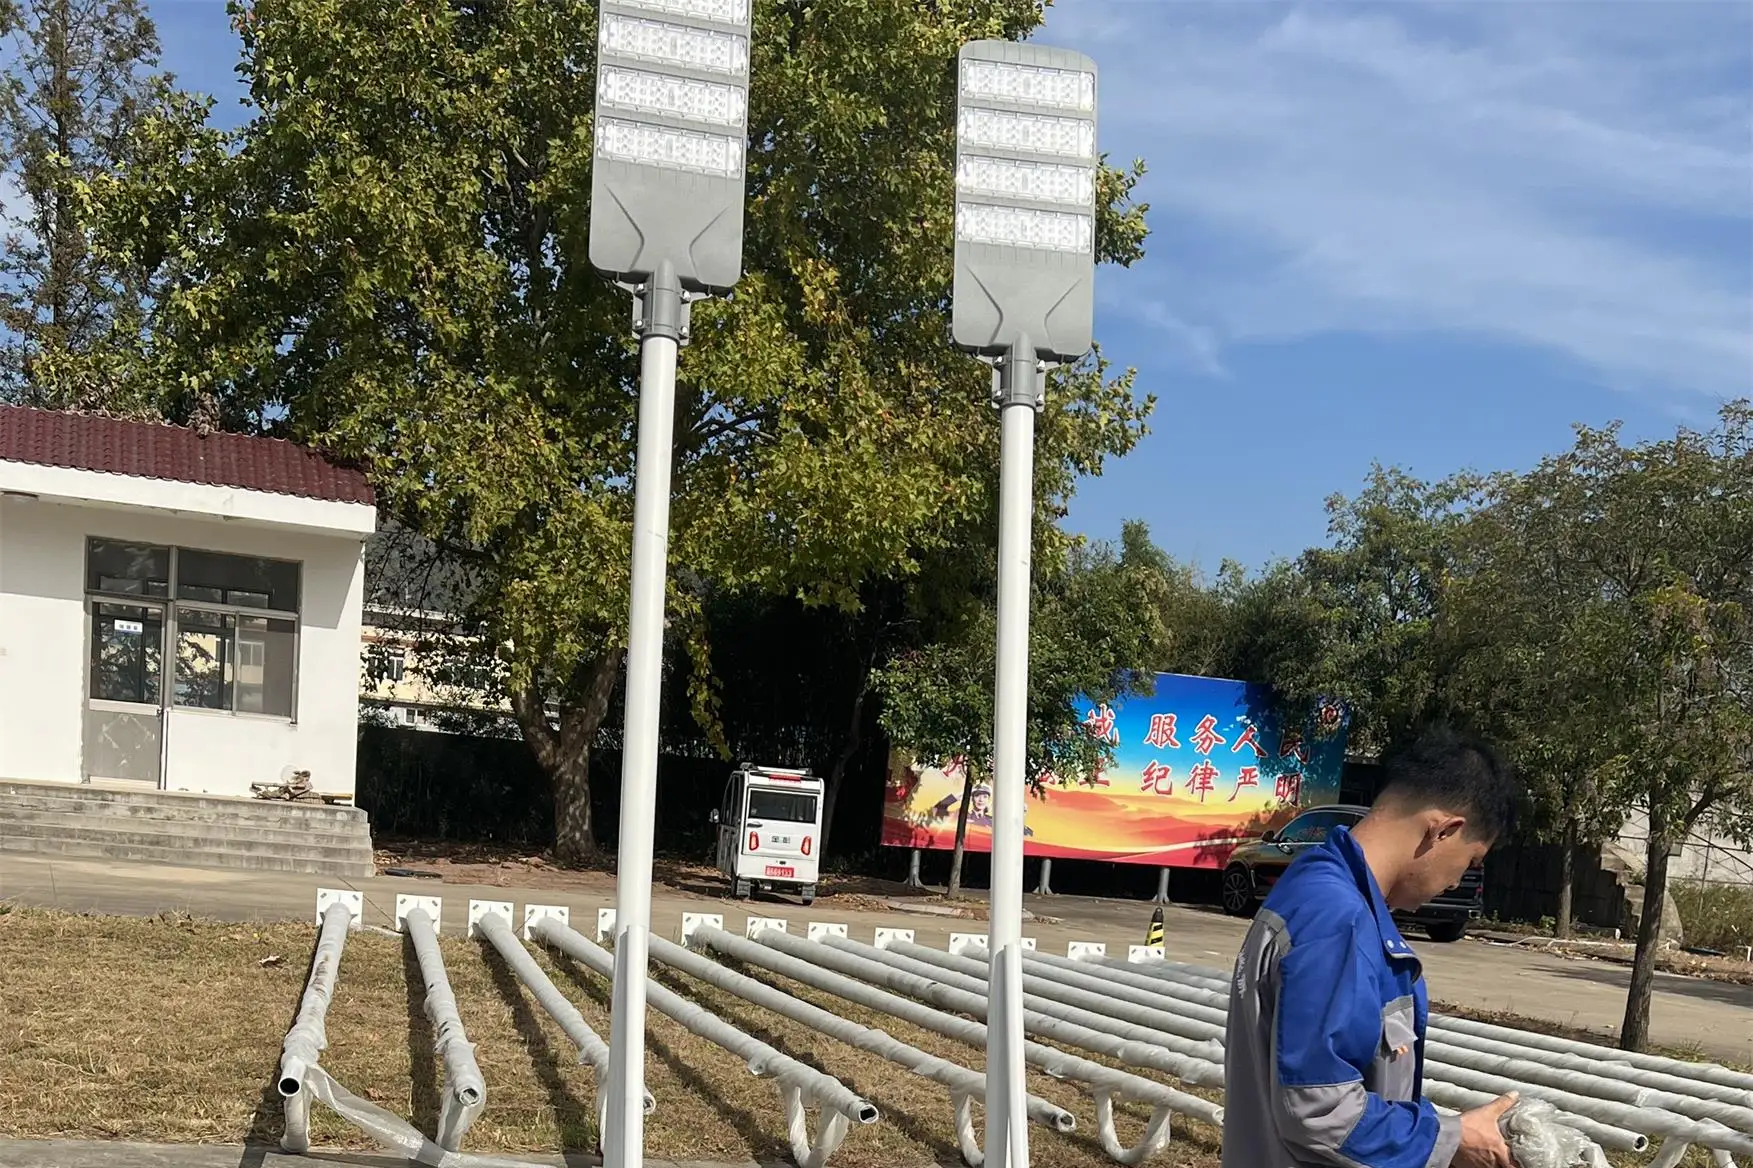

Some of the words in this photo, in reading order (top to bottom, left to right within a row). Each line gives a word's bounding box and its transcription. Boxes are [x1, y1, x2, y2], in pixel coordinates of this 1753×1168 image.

[1144, 713, 1311, 764] 服务人民
[1140, 759, 1304, 807] 纪律严明
